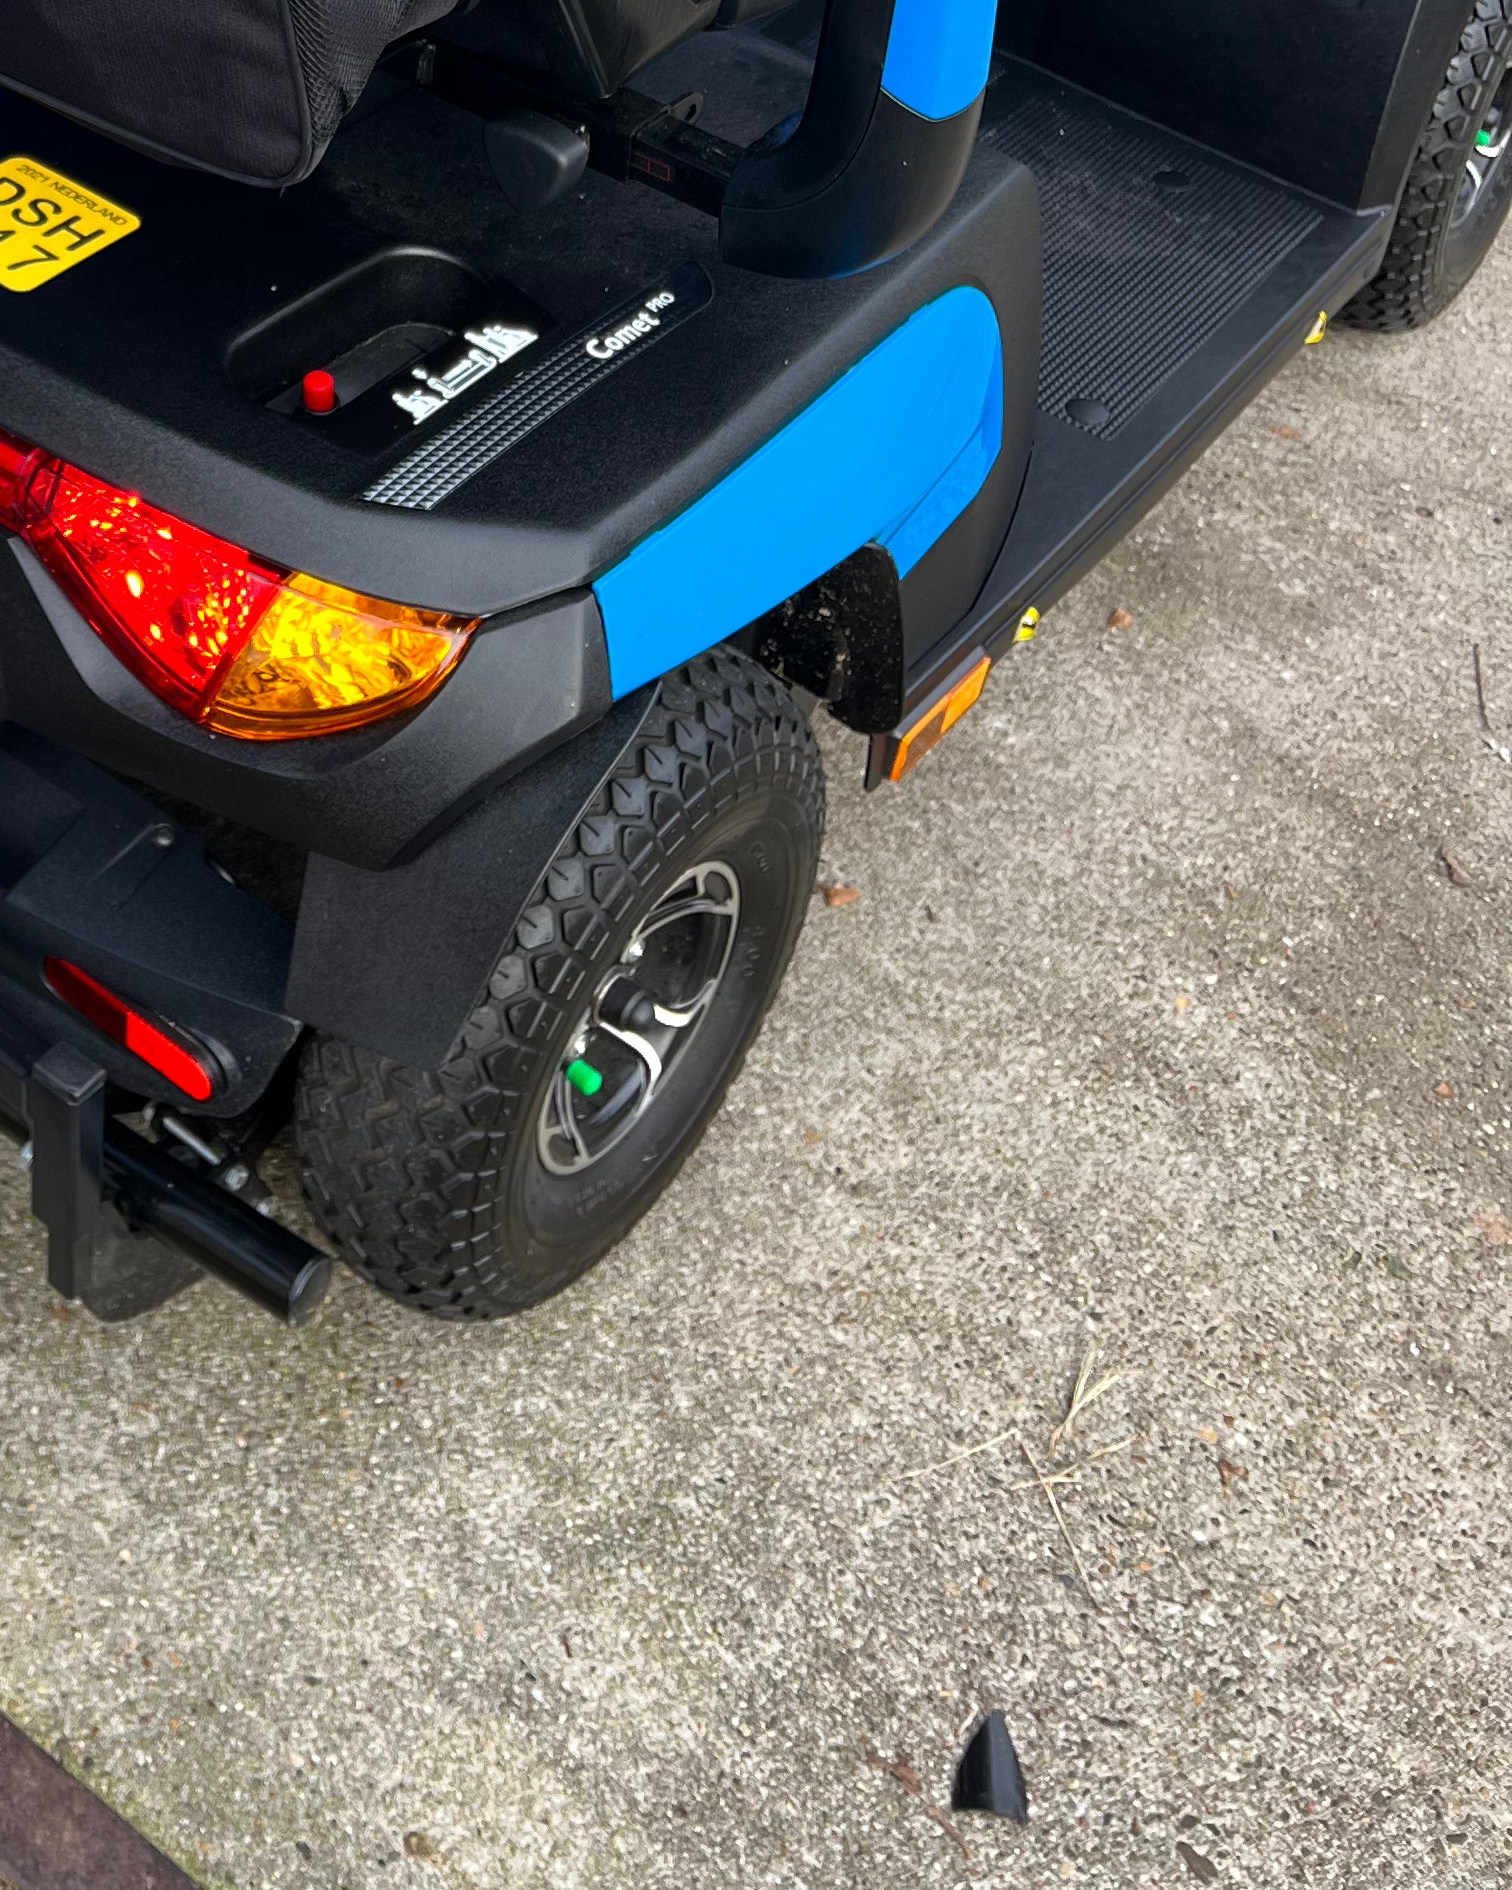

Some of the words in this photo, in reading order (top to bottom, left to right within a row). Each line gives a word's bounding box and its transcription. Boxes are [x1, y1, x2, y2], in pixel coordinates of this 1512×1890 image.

[49, 180, 128, 227] NEDERLAND
[586, 311, 660, 359] Comet
[645, 291, 675, 313] PRO
